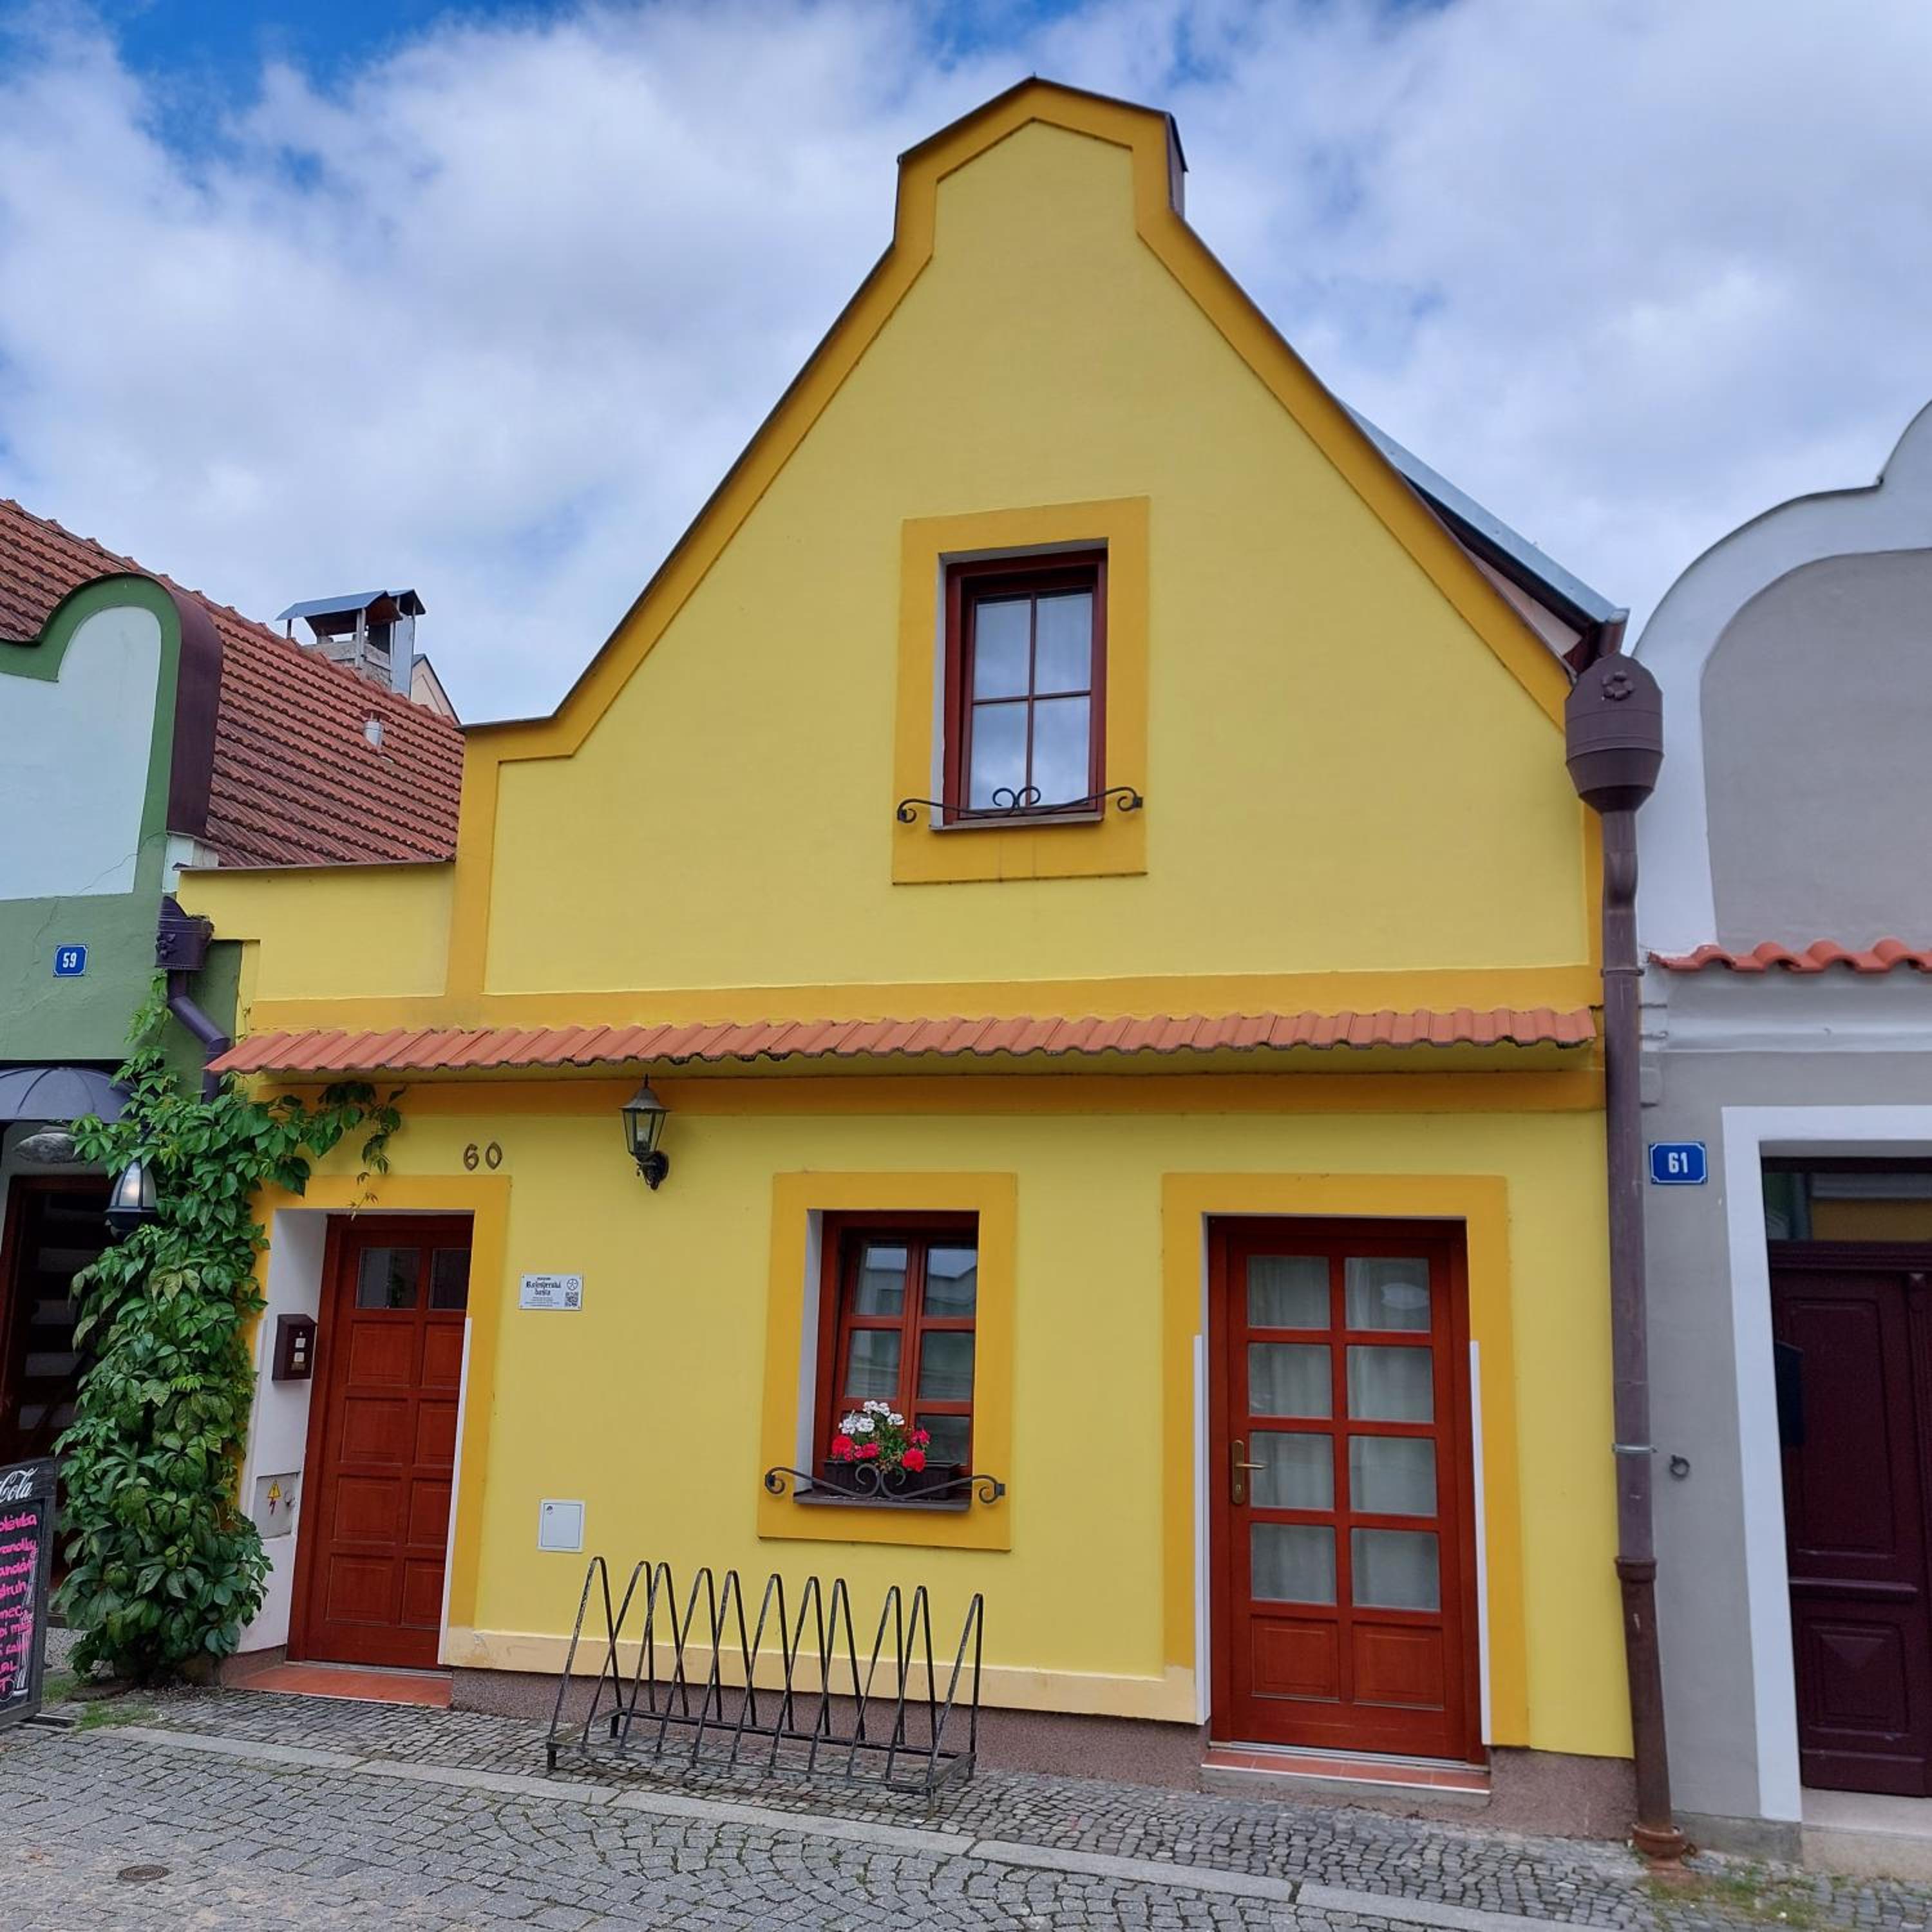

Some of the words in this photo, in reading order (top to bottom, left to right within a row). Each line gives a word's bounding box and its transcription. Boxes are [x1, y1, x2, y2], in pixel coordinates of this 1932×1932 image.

[62, 952, 77, 968] 59
[464, 1142, 502, 1171] 60
[1669, 1152, 1688, 1173] 61
